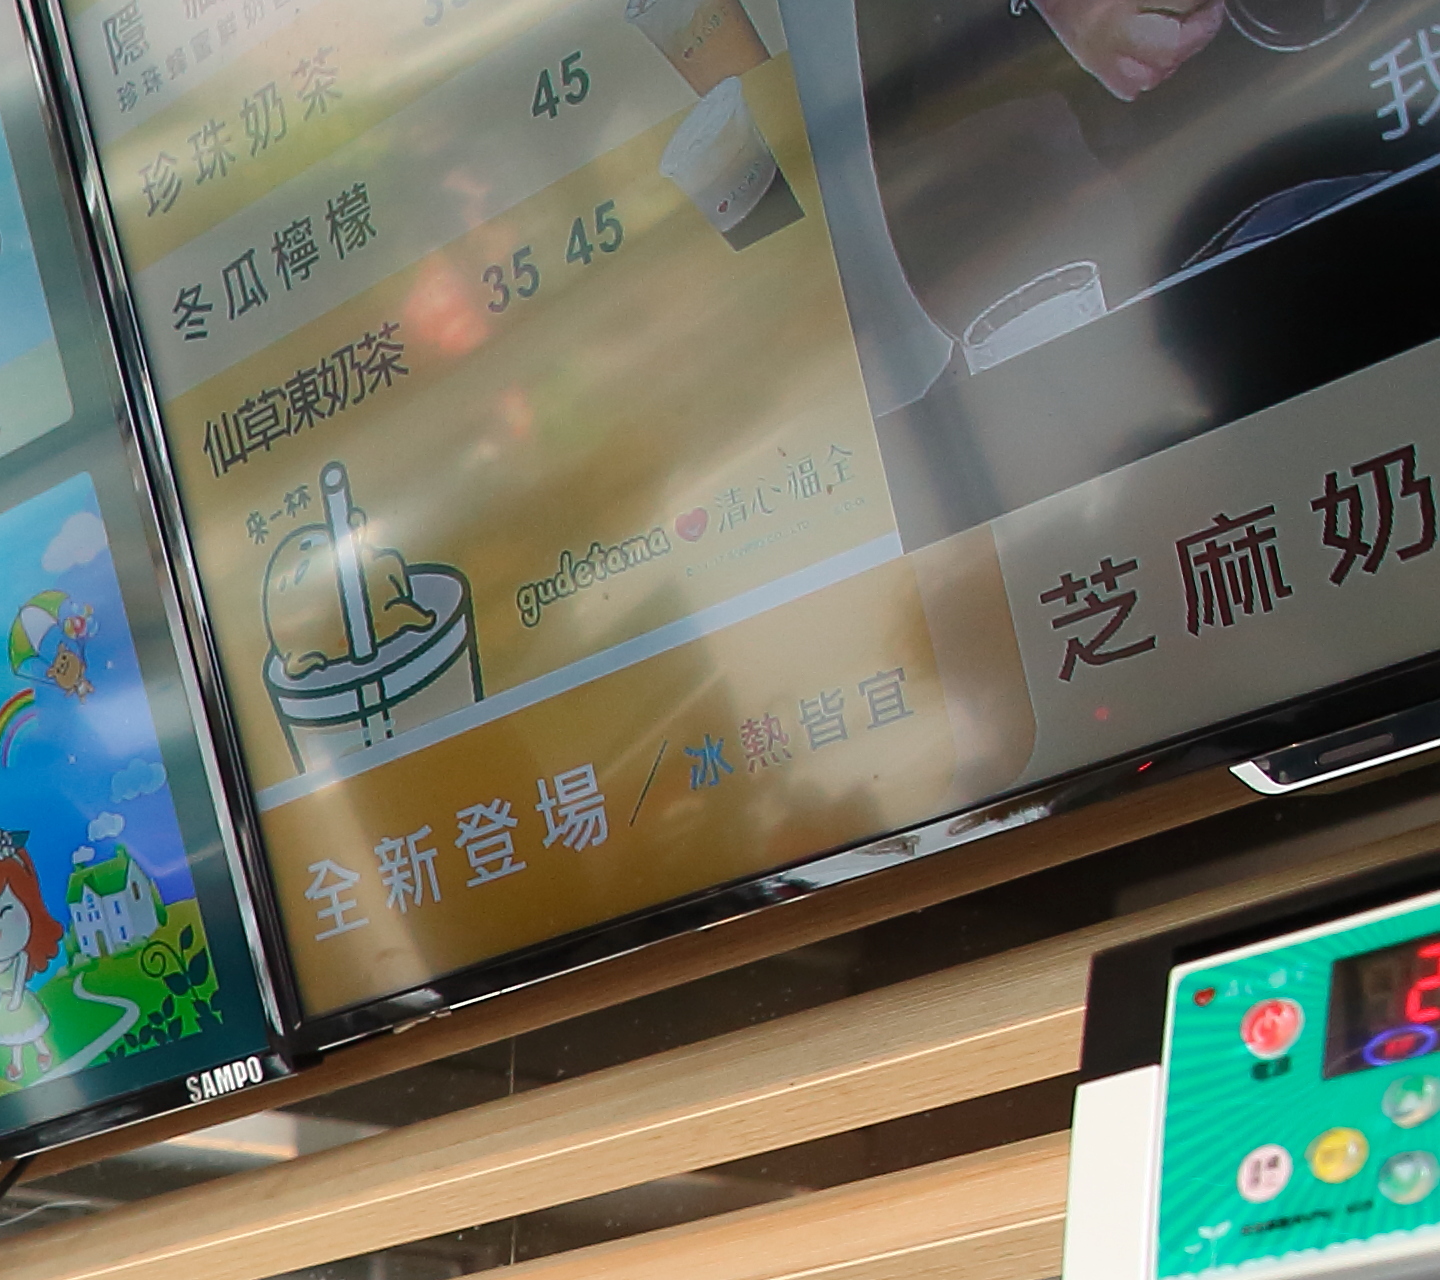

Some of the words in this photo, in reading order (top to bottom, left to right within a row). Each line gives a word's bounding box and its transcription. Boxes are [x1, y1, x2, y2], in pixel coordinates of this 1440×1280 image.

[138, 46, 343, 217] 珍珠奶茶
[172, 182, 377, 341] 冬瓜檸檬
[531, 50, 592, 120] 45
[482, 245, 541, 313] 35
[564, 198, 625, 266] 45
[714, 444, 854, 533] 清心福全
[516, 527, 671, 628] gudetama
[1040, 443, 1438, 682] 芝麻奶
[303, 762, 610, 942] 全新登場
[684, 666, 916, 791] 冰熱皆宜
[185, 1055, 264, 1103] SAMPO
